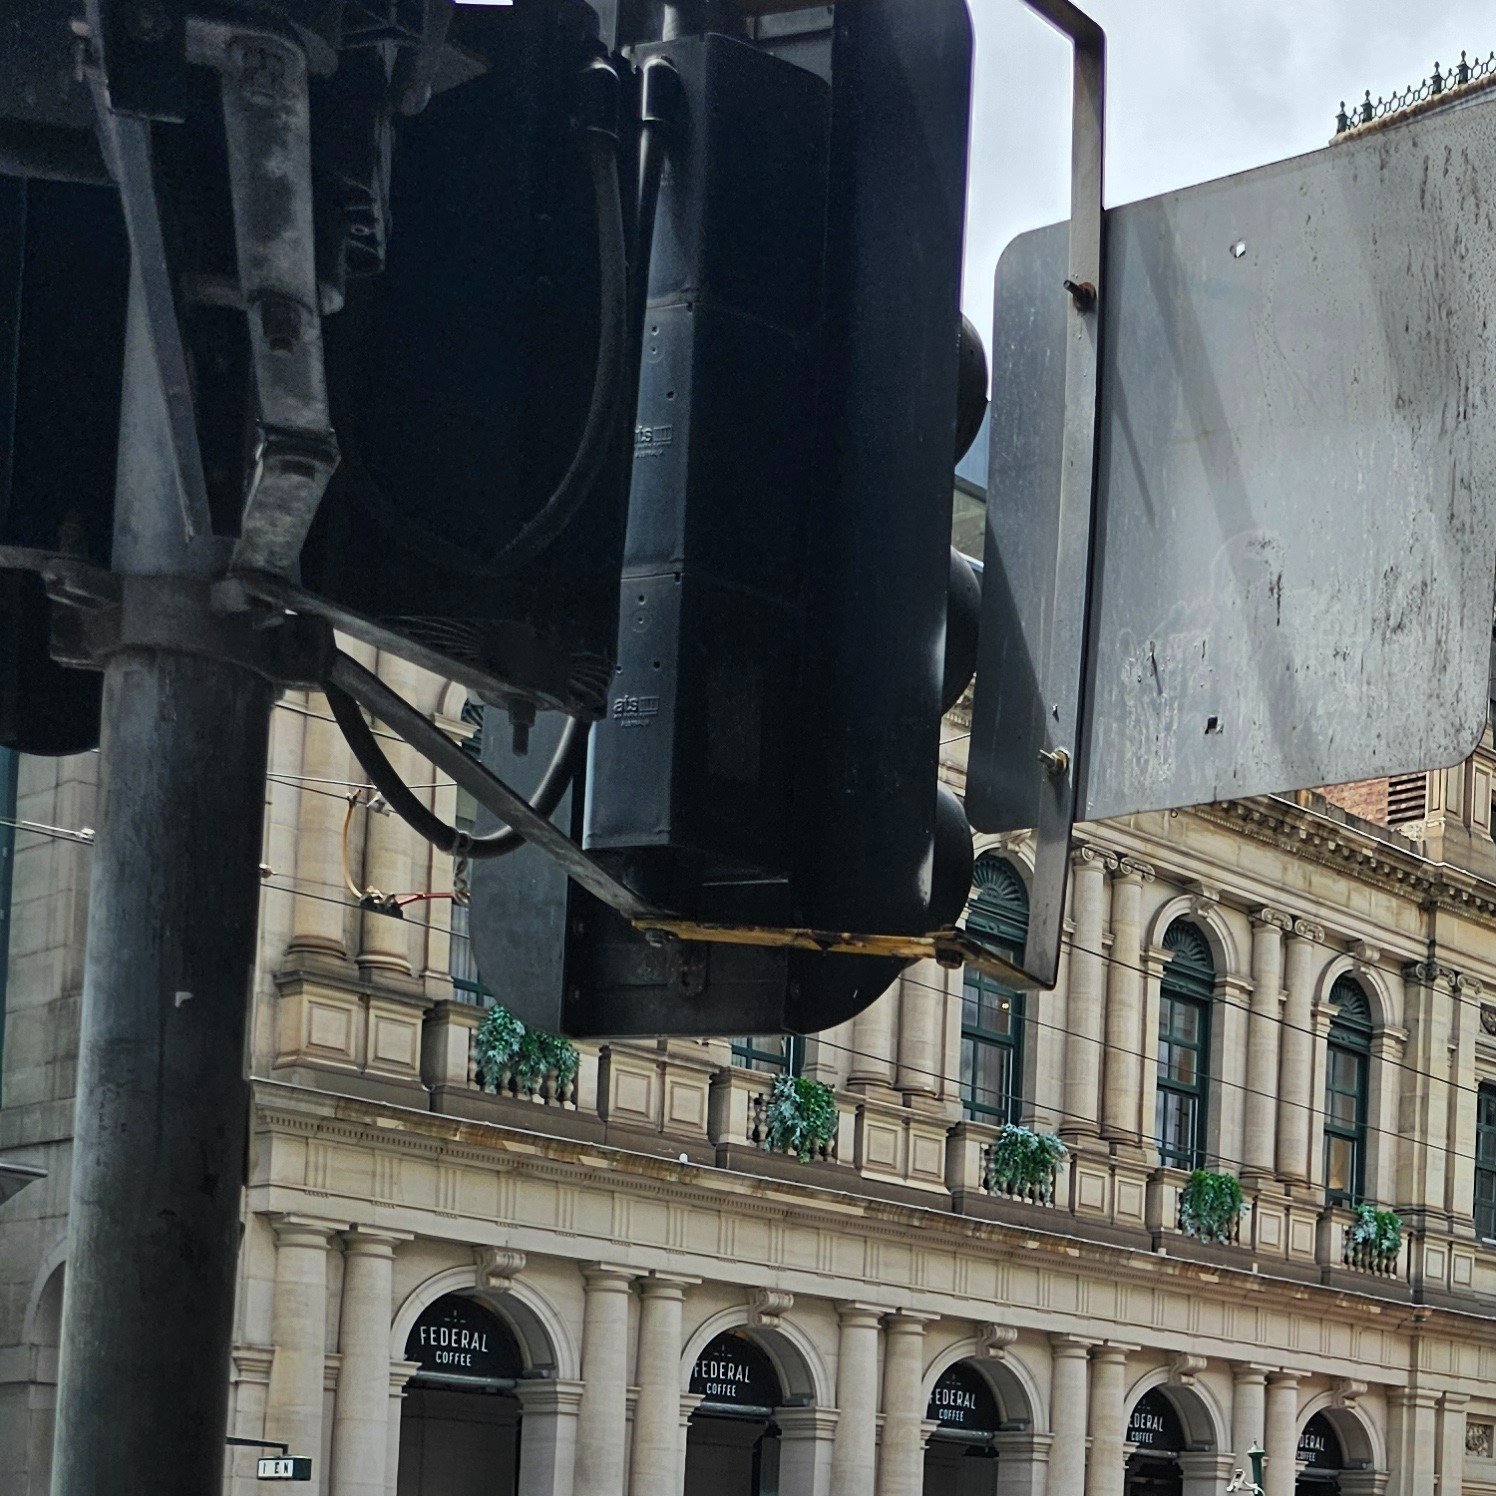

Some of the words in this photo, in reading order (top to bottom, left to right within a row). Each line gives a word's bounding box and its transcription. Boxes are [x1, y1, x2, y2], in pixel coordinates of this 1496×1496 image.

[420, 1326, 488, 1353] FEDERAL
[435, 1350, 472, 1367] COFFEE
[694, 1360, 750, 1383] FEDERAL
[706, 1382, 737, 1397] COFFEE
[938, 1408, 965, 1422] COFFEE
